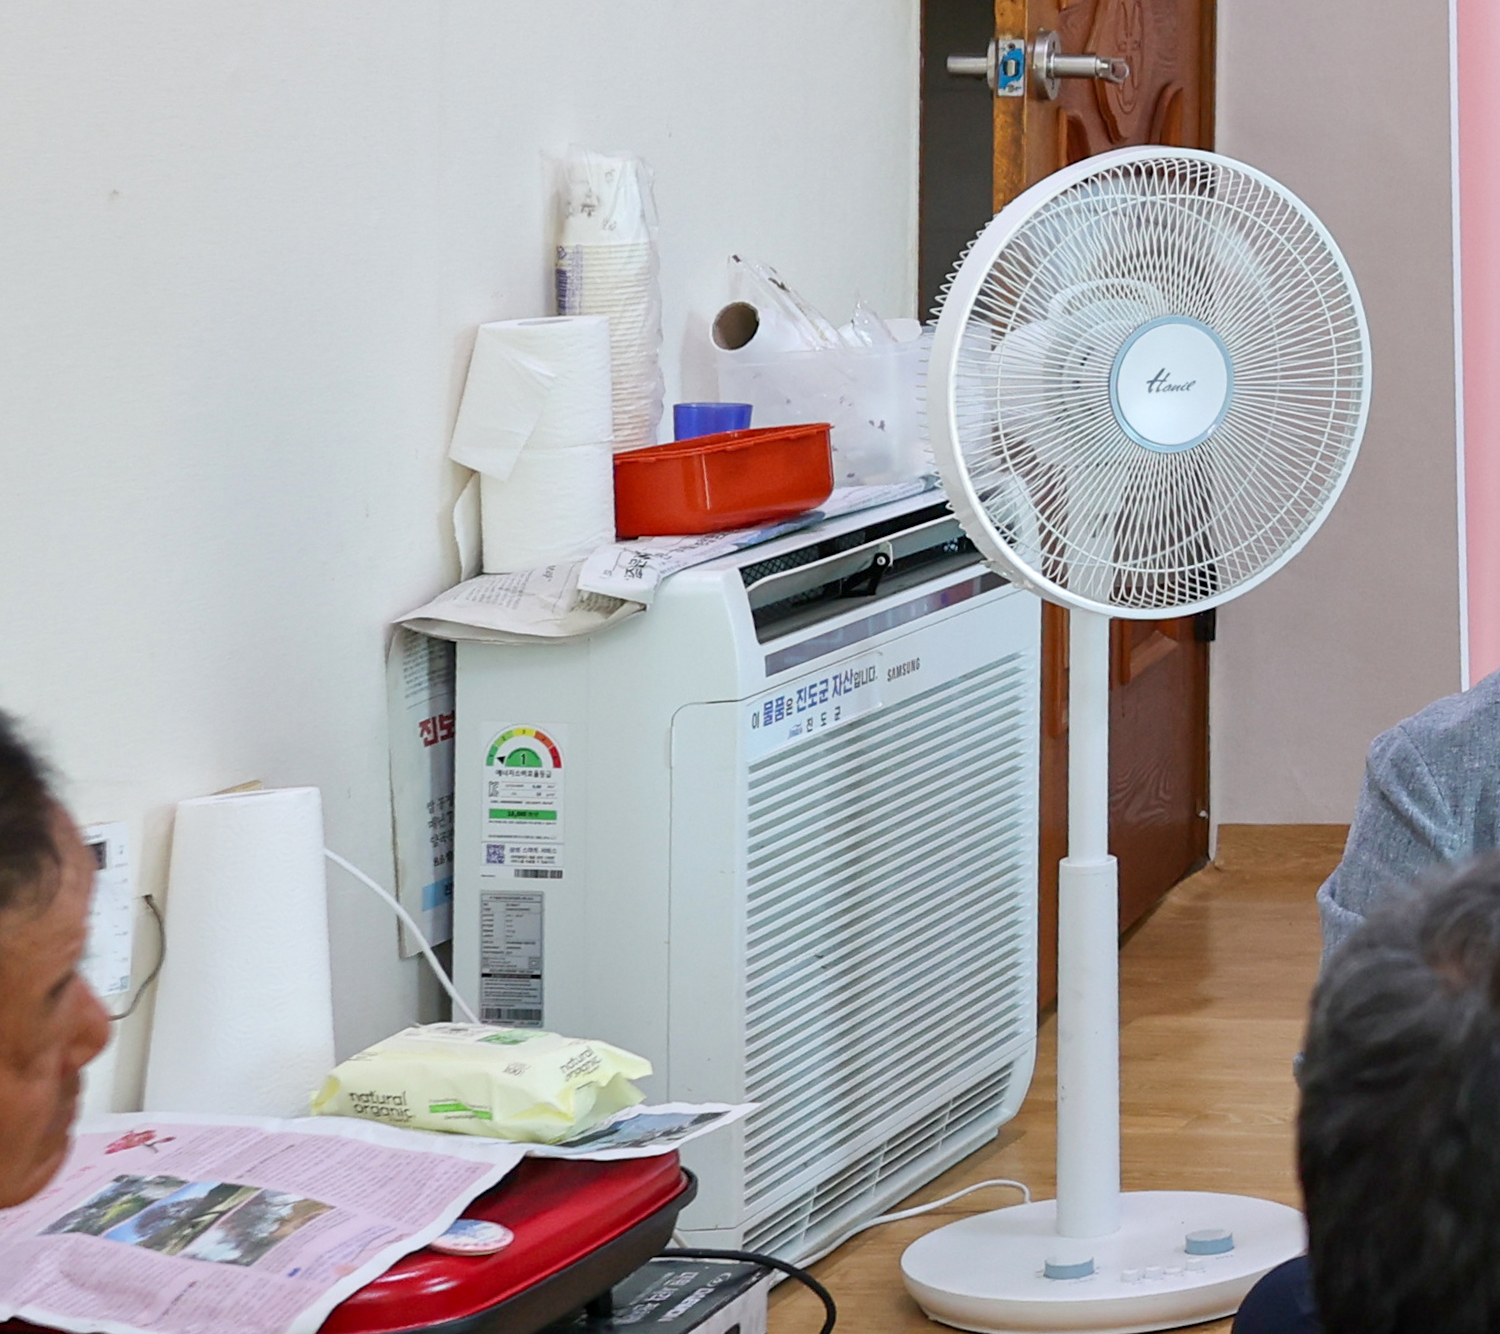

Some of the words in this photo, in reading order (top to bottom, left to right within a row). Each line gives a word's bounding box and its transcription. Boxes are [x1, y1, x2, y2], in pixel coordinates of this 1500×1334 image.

[1146, 367, 1197, 394] Hanil
[887, 657, 921, 682] SAMSUNG
[751, 711, 761, 730] 이
[763, 695, 793, 727] 물품은
[796, 677, 829, 714] 진도군
[831, 665, 879, 699] 자산입니다.
[559, 1046, 595, 1074] natural
[348, 1090, 407, 1107] natural
[353, 1103, 413, 1118] organic
